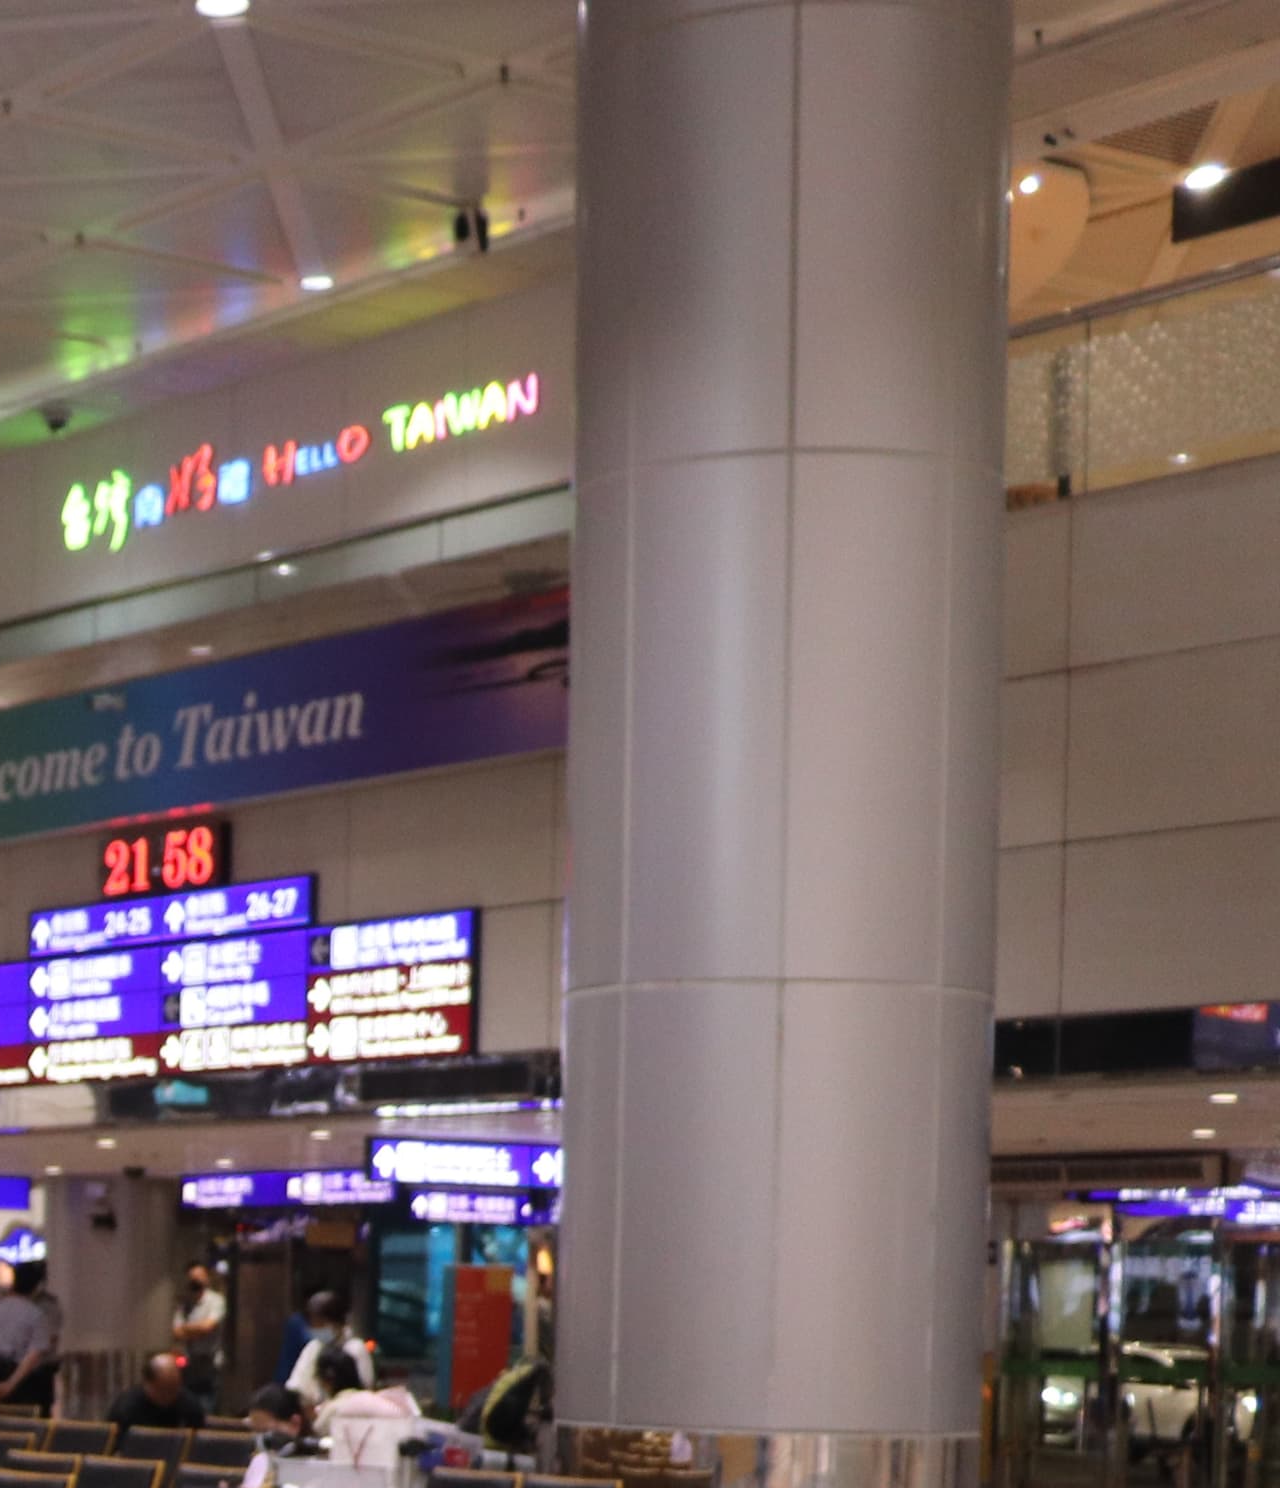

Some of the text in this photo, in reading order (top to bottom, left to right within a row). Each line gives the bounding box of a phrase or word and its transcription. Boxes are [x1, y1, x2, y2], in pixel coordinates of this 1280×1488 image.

[262, 424, 370, 486] HELLO
[382, 371, 537, 453] TAIWAN
[115, 723, 161, 780] to
[174, 690, 365, 771] Taiwan
